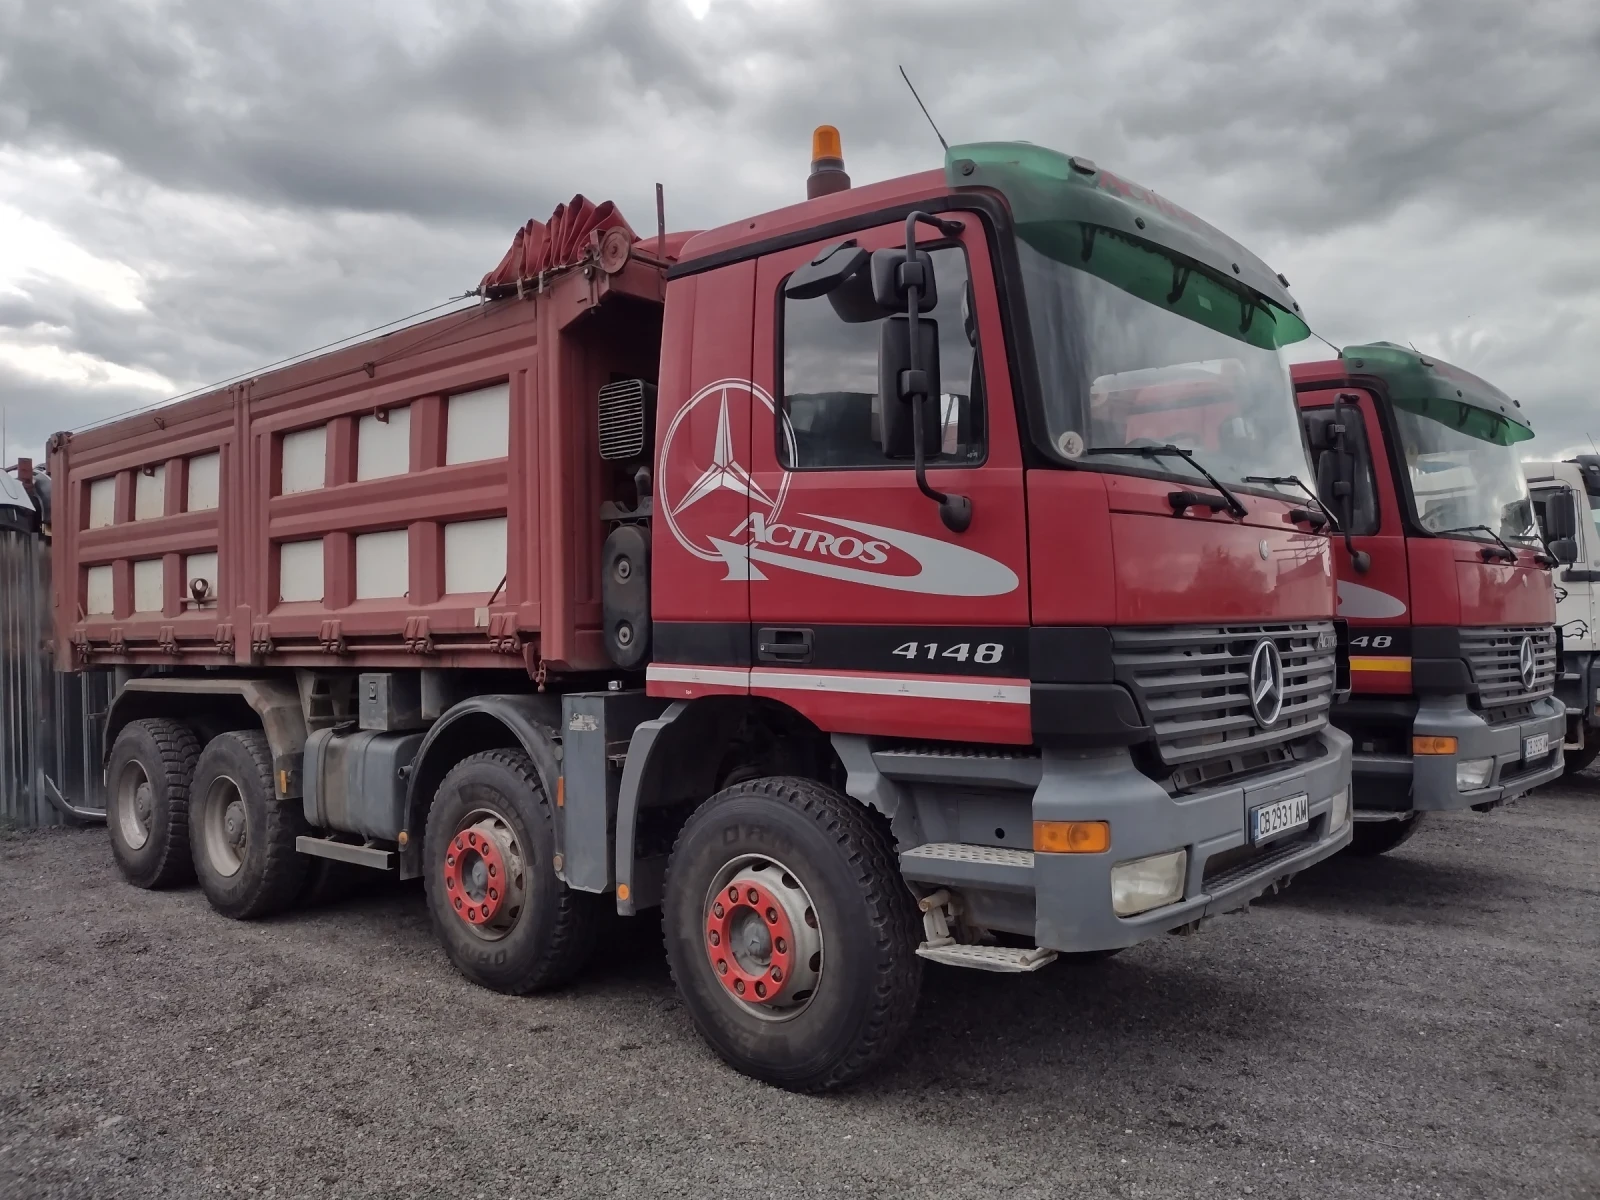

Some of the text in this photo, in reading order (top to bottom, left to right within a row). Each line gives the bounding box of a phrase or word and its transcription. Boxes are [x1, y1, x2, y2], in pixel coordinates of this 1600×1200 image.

[729, 511, 891, 564] ACTROS
[892, 642, 1004, 664] 4148
[1272, 803, 1292, 830] 2931
[1295, 799, 1307, 822] AM
